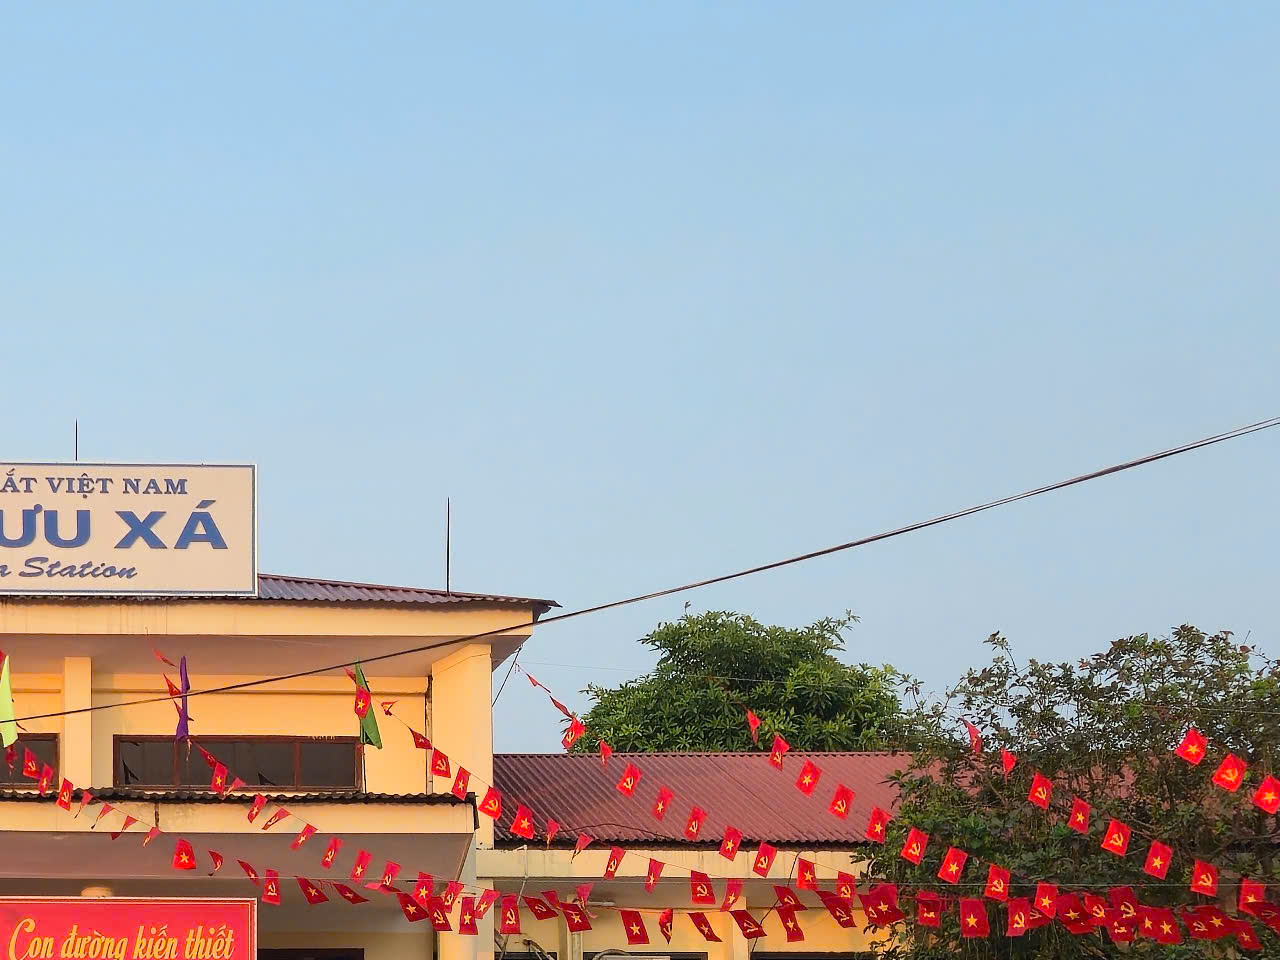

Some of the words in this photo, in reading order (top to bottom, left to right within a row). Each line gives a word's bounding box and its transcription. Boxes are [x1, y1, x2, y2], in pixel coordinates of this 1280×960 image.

[45, 473, 114, 499] VIỆT
[122, 478, 189, 495] NAM
[114, 500, 228, 549] XÁ
[18, 556, 138, 579] Station
[133, 924, 179, 960] kiến
[184, 924, 235, 960] thiết
